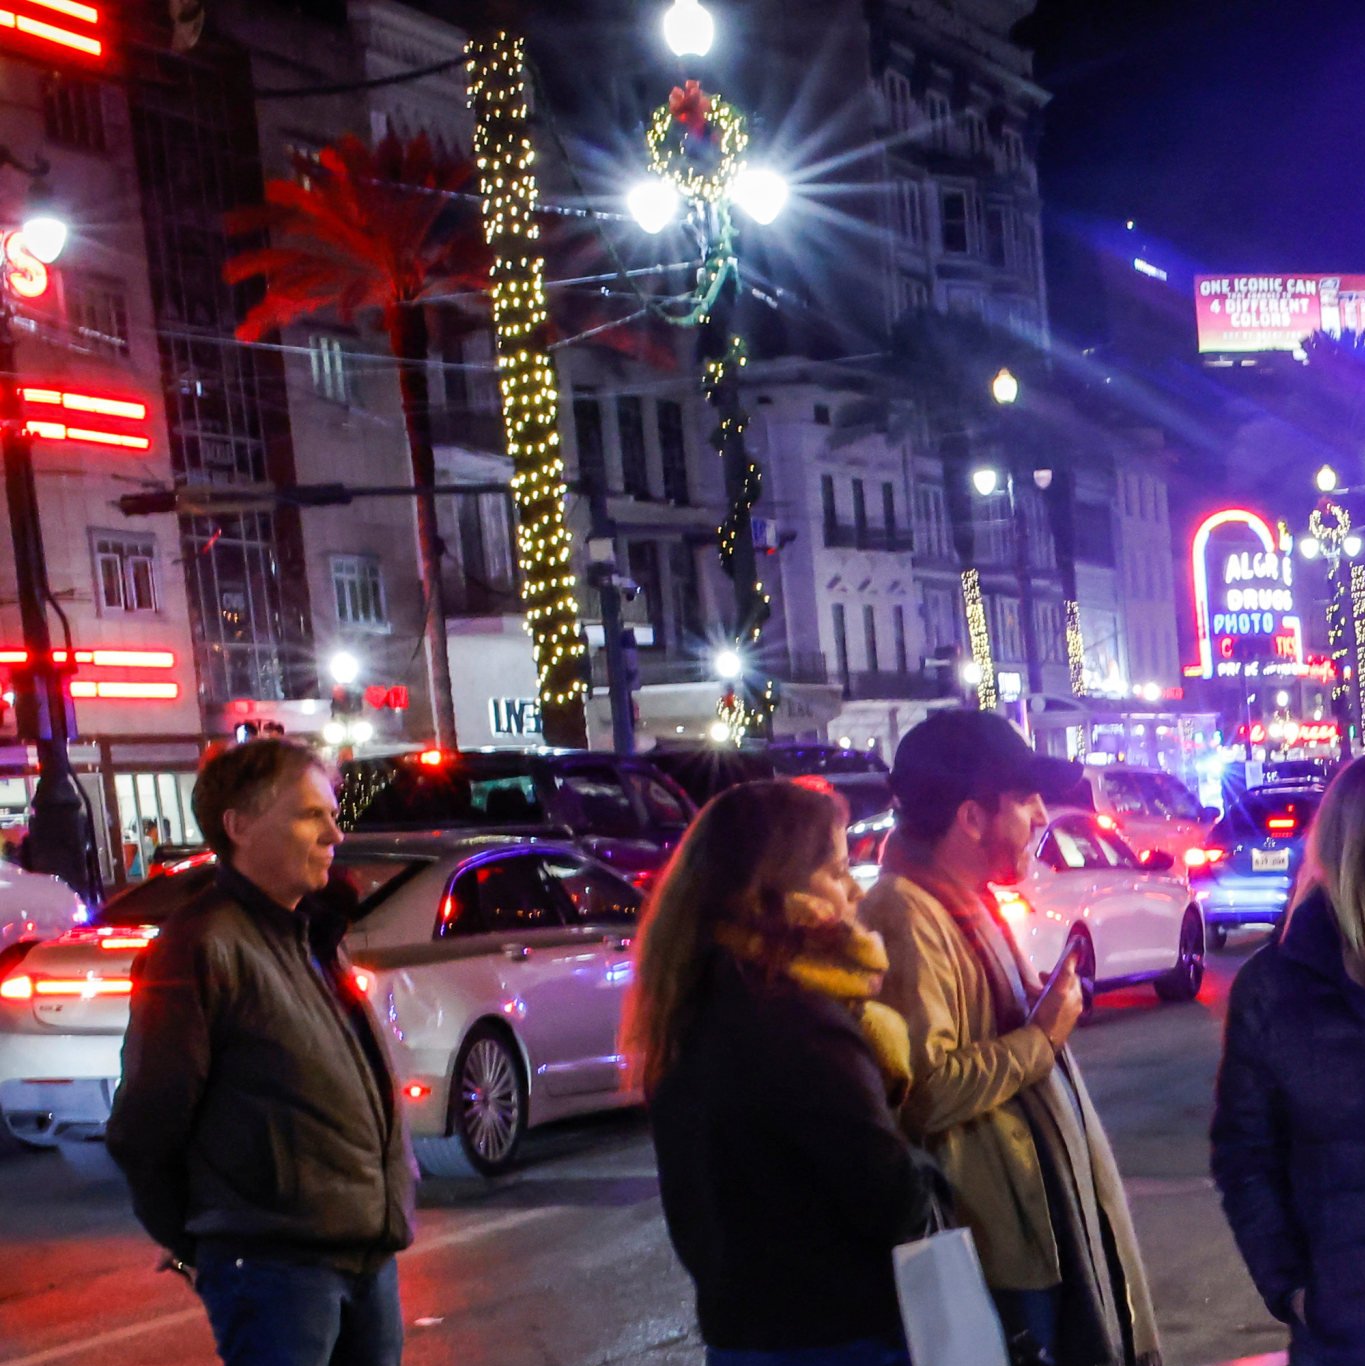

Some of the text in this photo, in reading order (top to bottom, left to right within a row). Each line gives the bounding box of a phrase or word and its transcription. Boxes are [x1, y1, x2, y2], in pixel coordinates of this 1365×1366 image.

[1200, 277, 1317, 296] ONE ICONIC CAN
[1209, 298, 1310, 315] 4 DIFFERENT
[1231, 312, 1291, 328] COLORS
[1214, 612, 1274, 635] PHOTO
